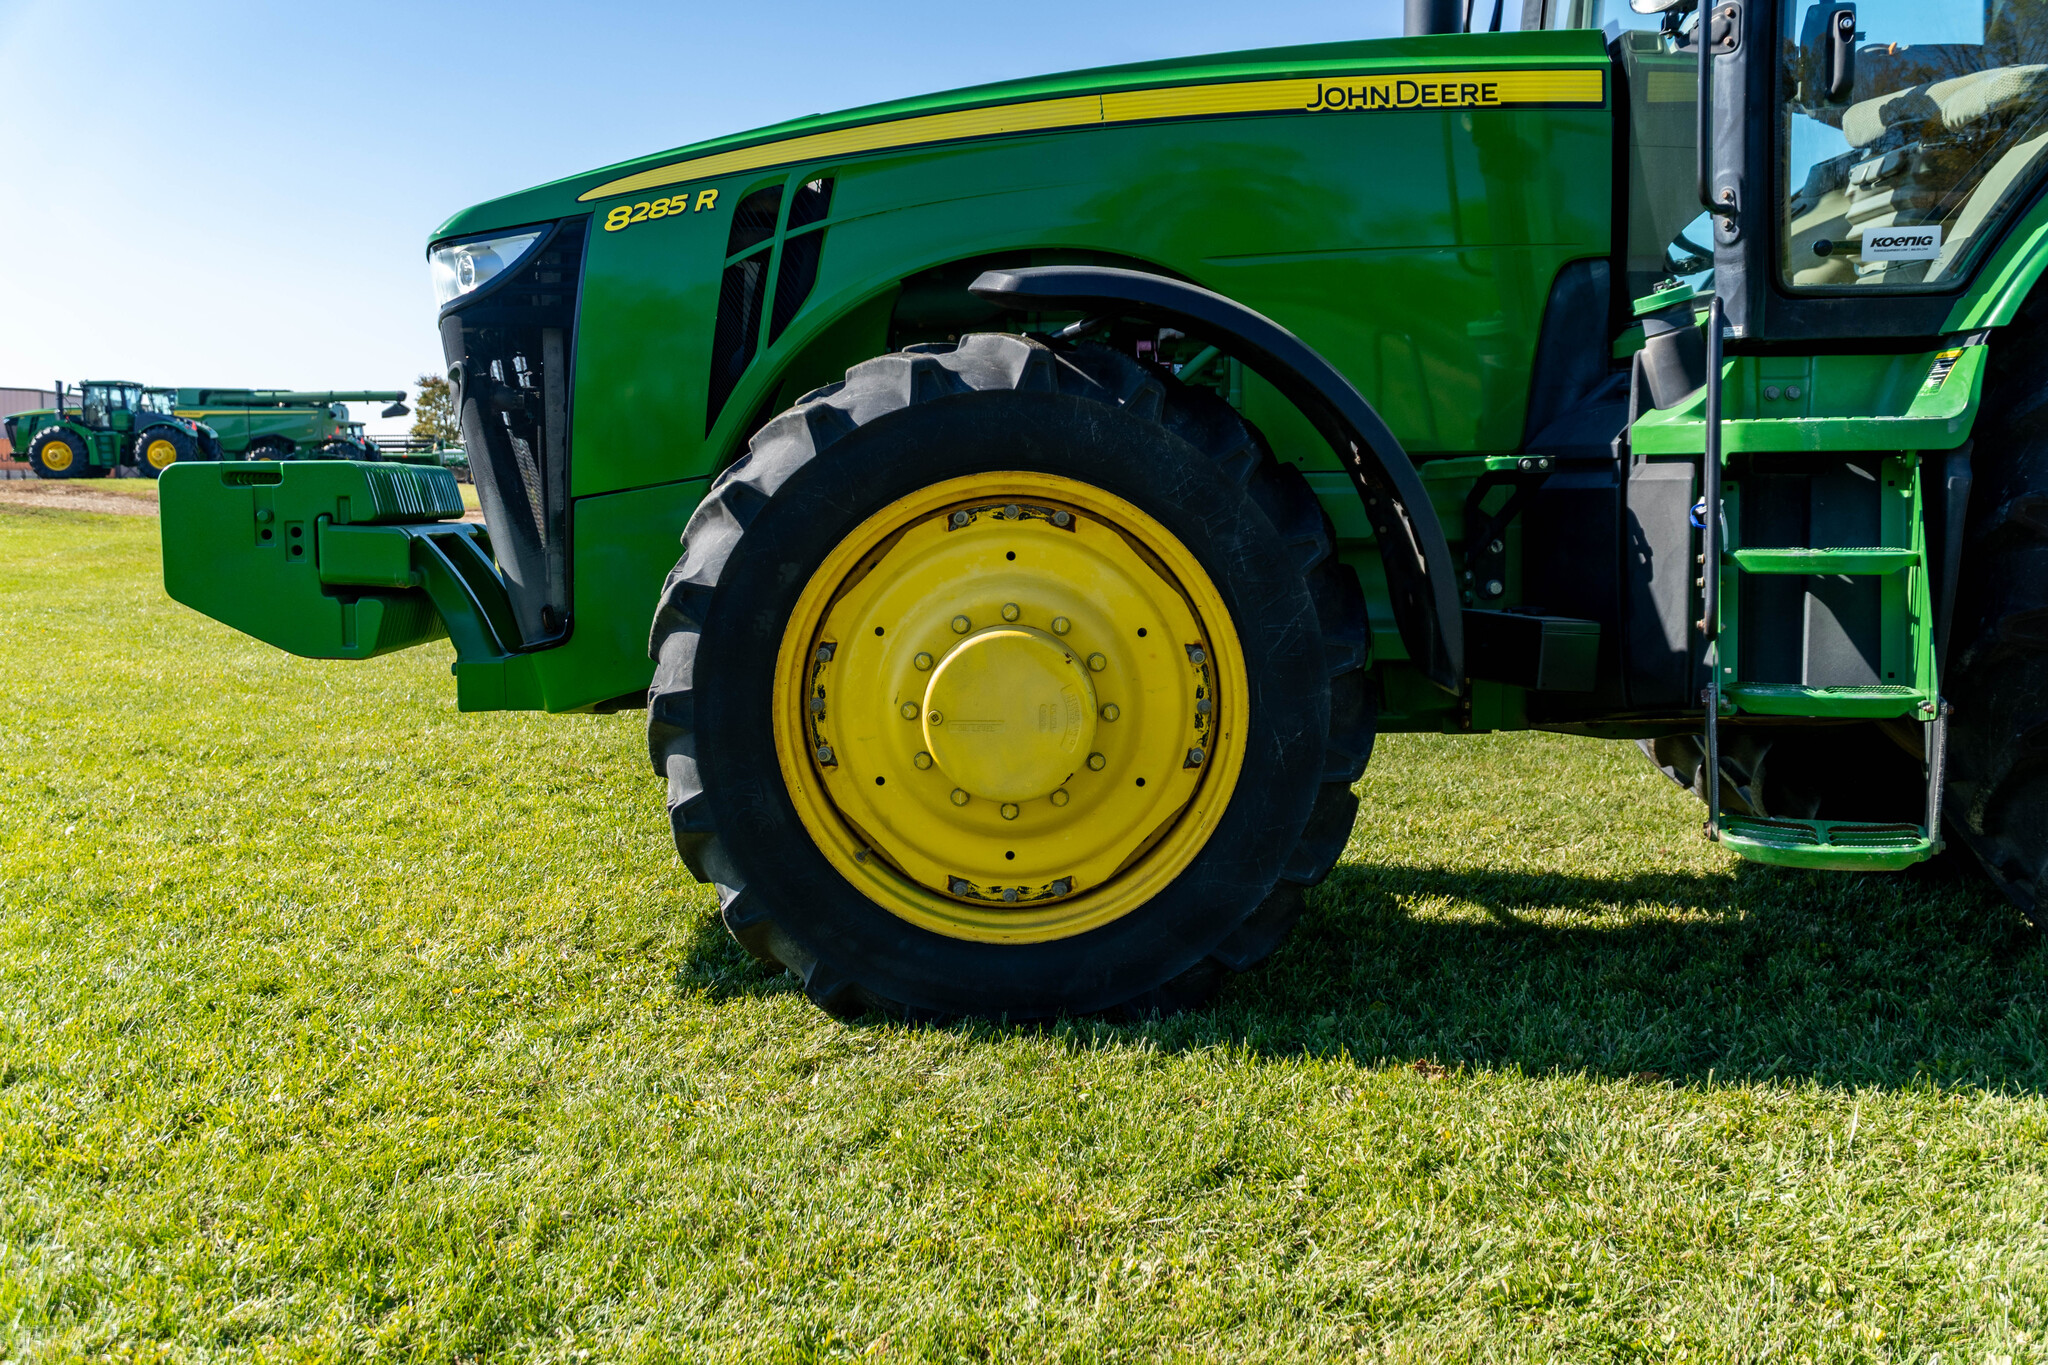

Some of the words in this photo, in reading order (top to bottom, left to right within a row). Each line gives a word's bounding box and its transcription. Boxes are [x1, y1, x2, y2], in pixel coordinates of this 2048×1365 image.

[1306, 83, 1391, 109] JOHN
[1396, 80, 1499, 106] DEERE
[603, 192, 690, 232] 8285
[694, 188, 719, 213] R
